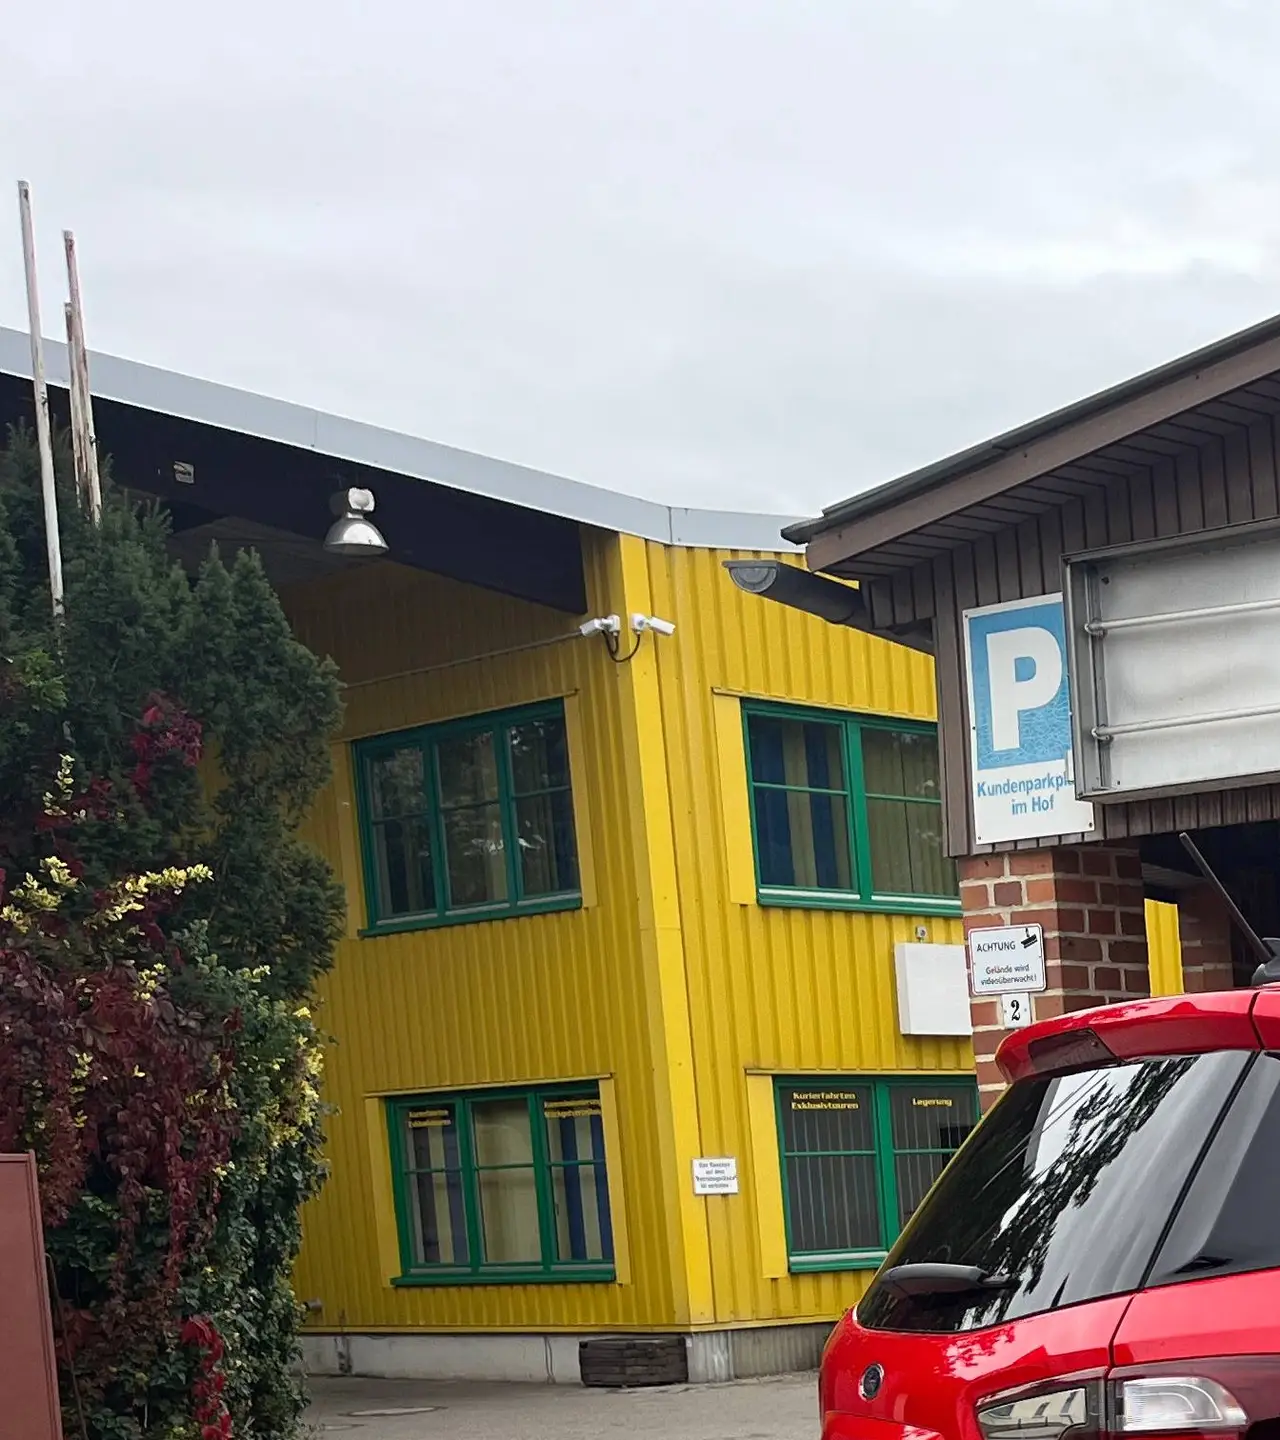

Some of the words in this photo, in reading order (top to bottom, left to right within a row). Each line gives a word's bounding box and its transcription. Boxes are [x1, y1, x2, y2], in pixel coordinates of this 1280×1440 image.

[986, 626, 1062, 751] P
[1011, 799, 1027, 815] im
[1032, 794, 1054, 812] Hof
[976, 940, 1016, 953] ACHTUNG
[985, 964, 1012, 975] Gelände
[1014, 963, 1030, 973] wird
[1010, 999, 1021, 1021] 2
